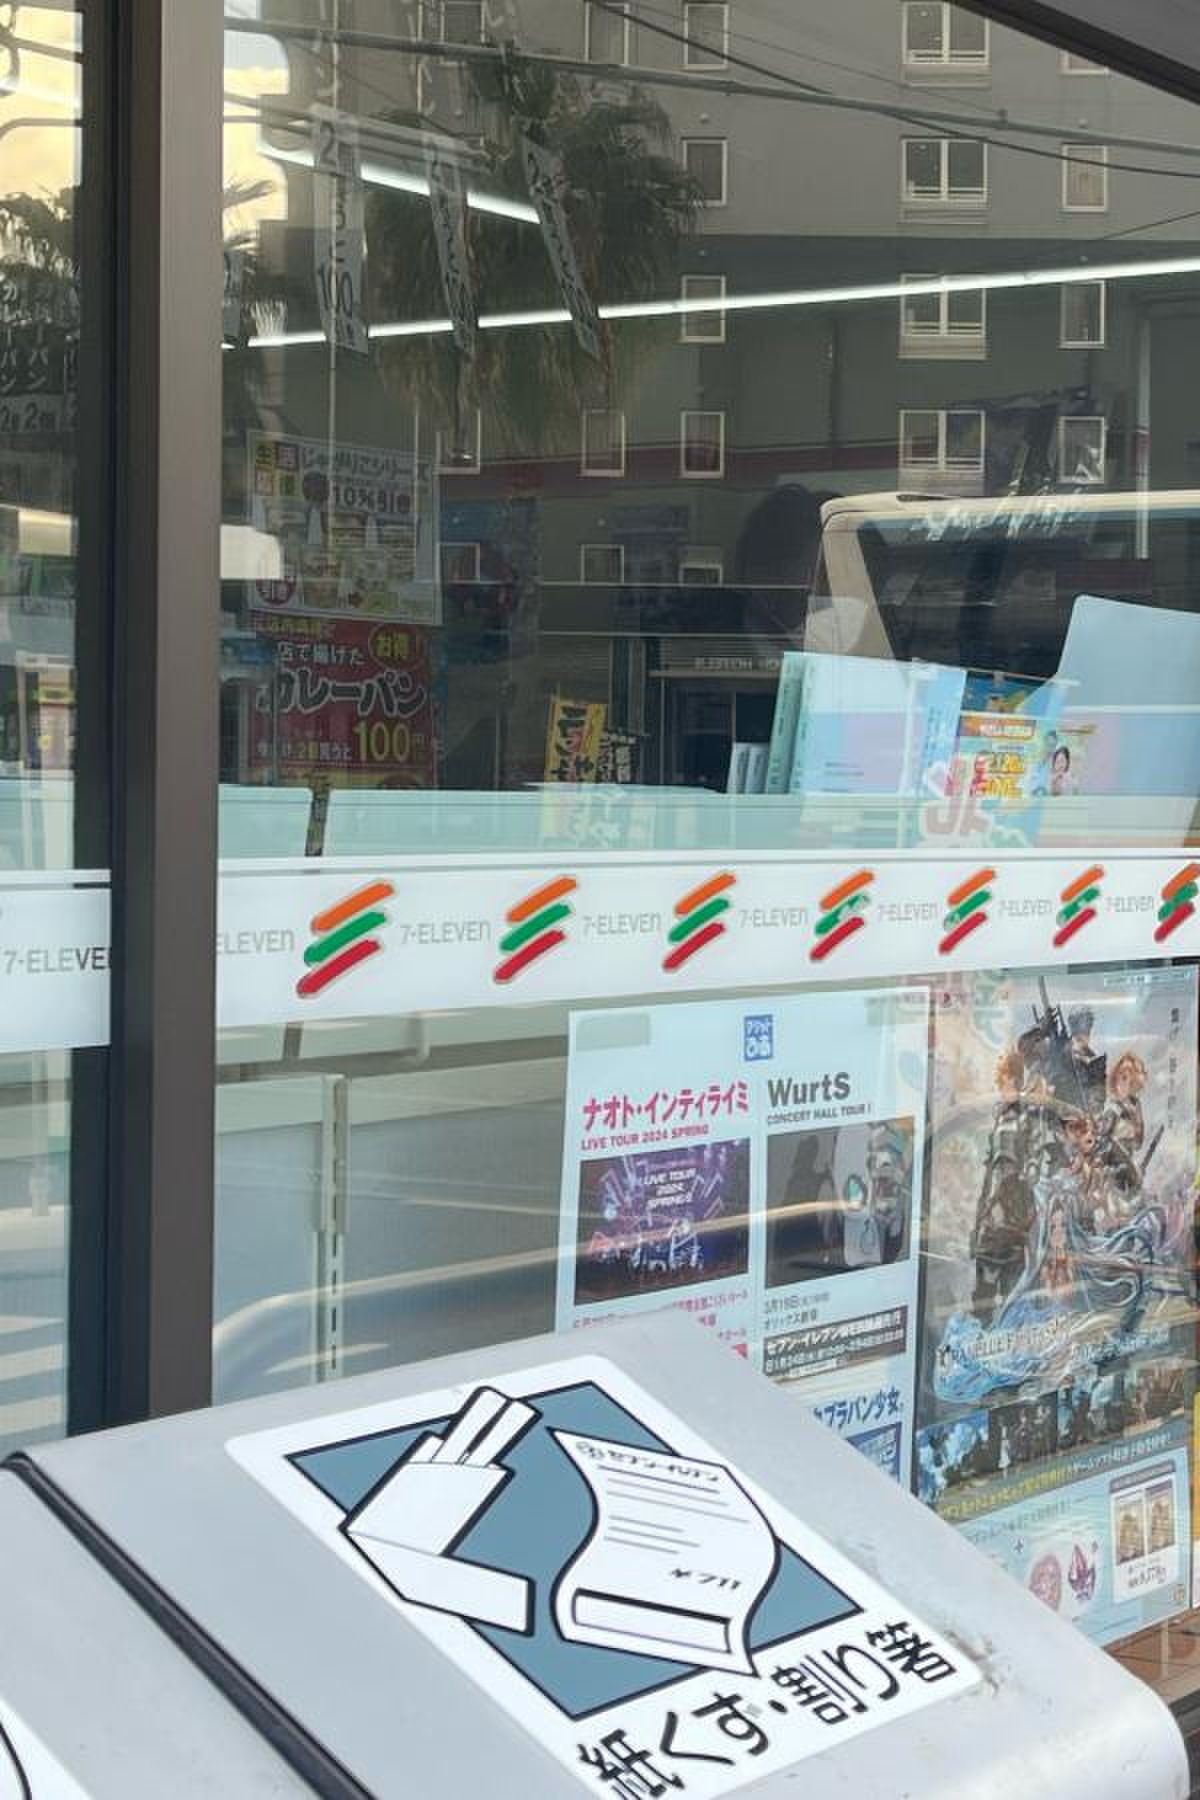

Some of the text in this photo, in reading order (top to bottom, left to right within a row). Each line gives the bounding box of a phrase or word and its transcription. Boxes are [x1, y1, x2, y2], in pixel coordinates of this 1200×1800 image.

[582, 1080, 750, 1131] ナオト・インティライミ
[767, 1072, 851, 1108] WurtS
[813, 1106, 839, 1120] HALL
[581, 1138, 608, 1151] LIVE
[610, 1134, 640, 1147] TOUR
[576, 1620, 958, 1800] 紙くず・割り箸
